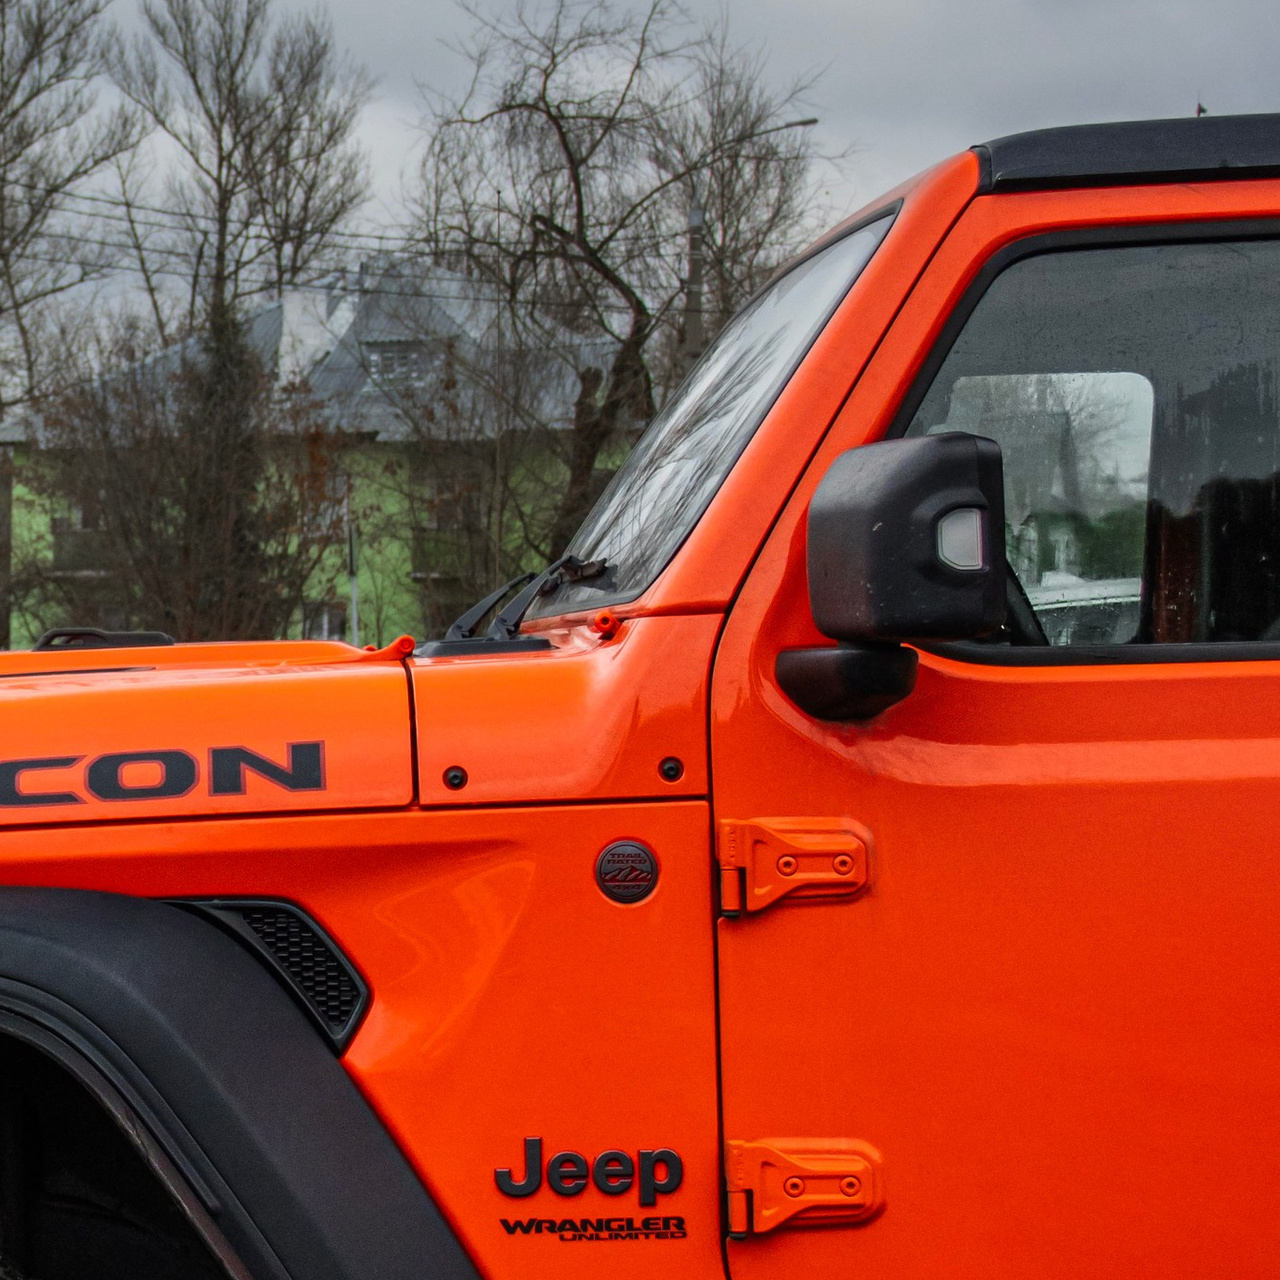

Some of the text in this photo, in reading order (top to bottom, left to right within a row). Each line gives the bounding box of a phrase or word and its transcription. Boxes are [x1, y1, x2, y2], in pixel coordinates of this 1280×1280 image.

[494, 1136, 683, 1207] Jeep
[499, 1216, 687, 1234] WRANGLER
[558, 1231, 688, 1242] UNLIMITED
